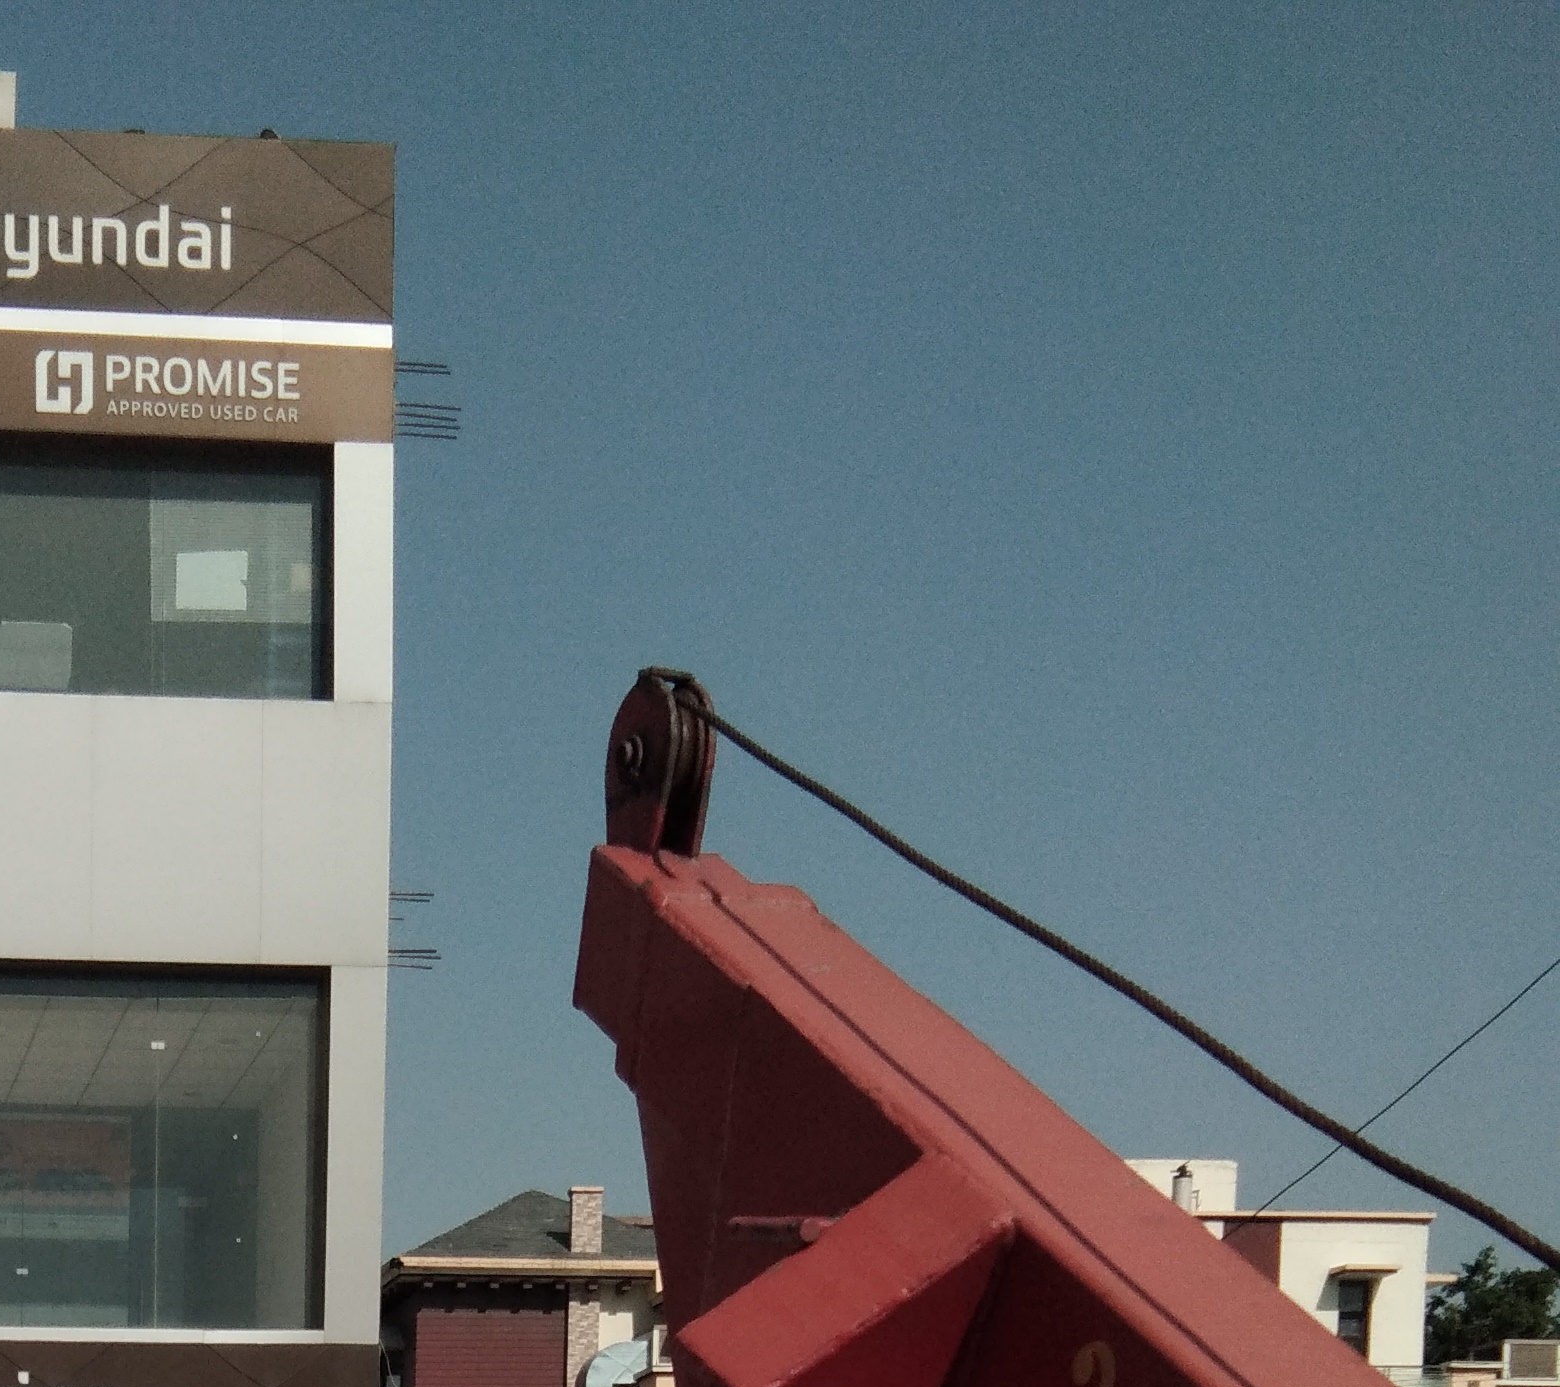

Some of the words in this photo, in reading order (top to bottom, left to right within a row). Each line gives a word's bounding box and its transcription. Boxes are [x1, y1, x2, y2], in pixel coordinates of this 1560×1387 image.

[105, 354, 300, 399] PROMISE
[107, 399, 203, 420] APPROVED
[210, 402, 257, 421] USED
[263, 405, 298, 423] CAR
